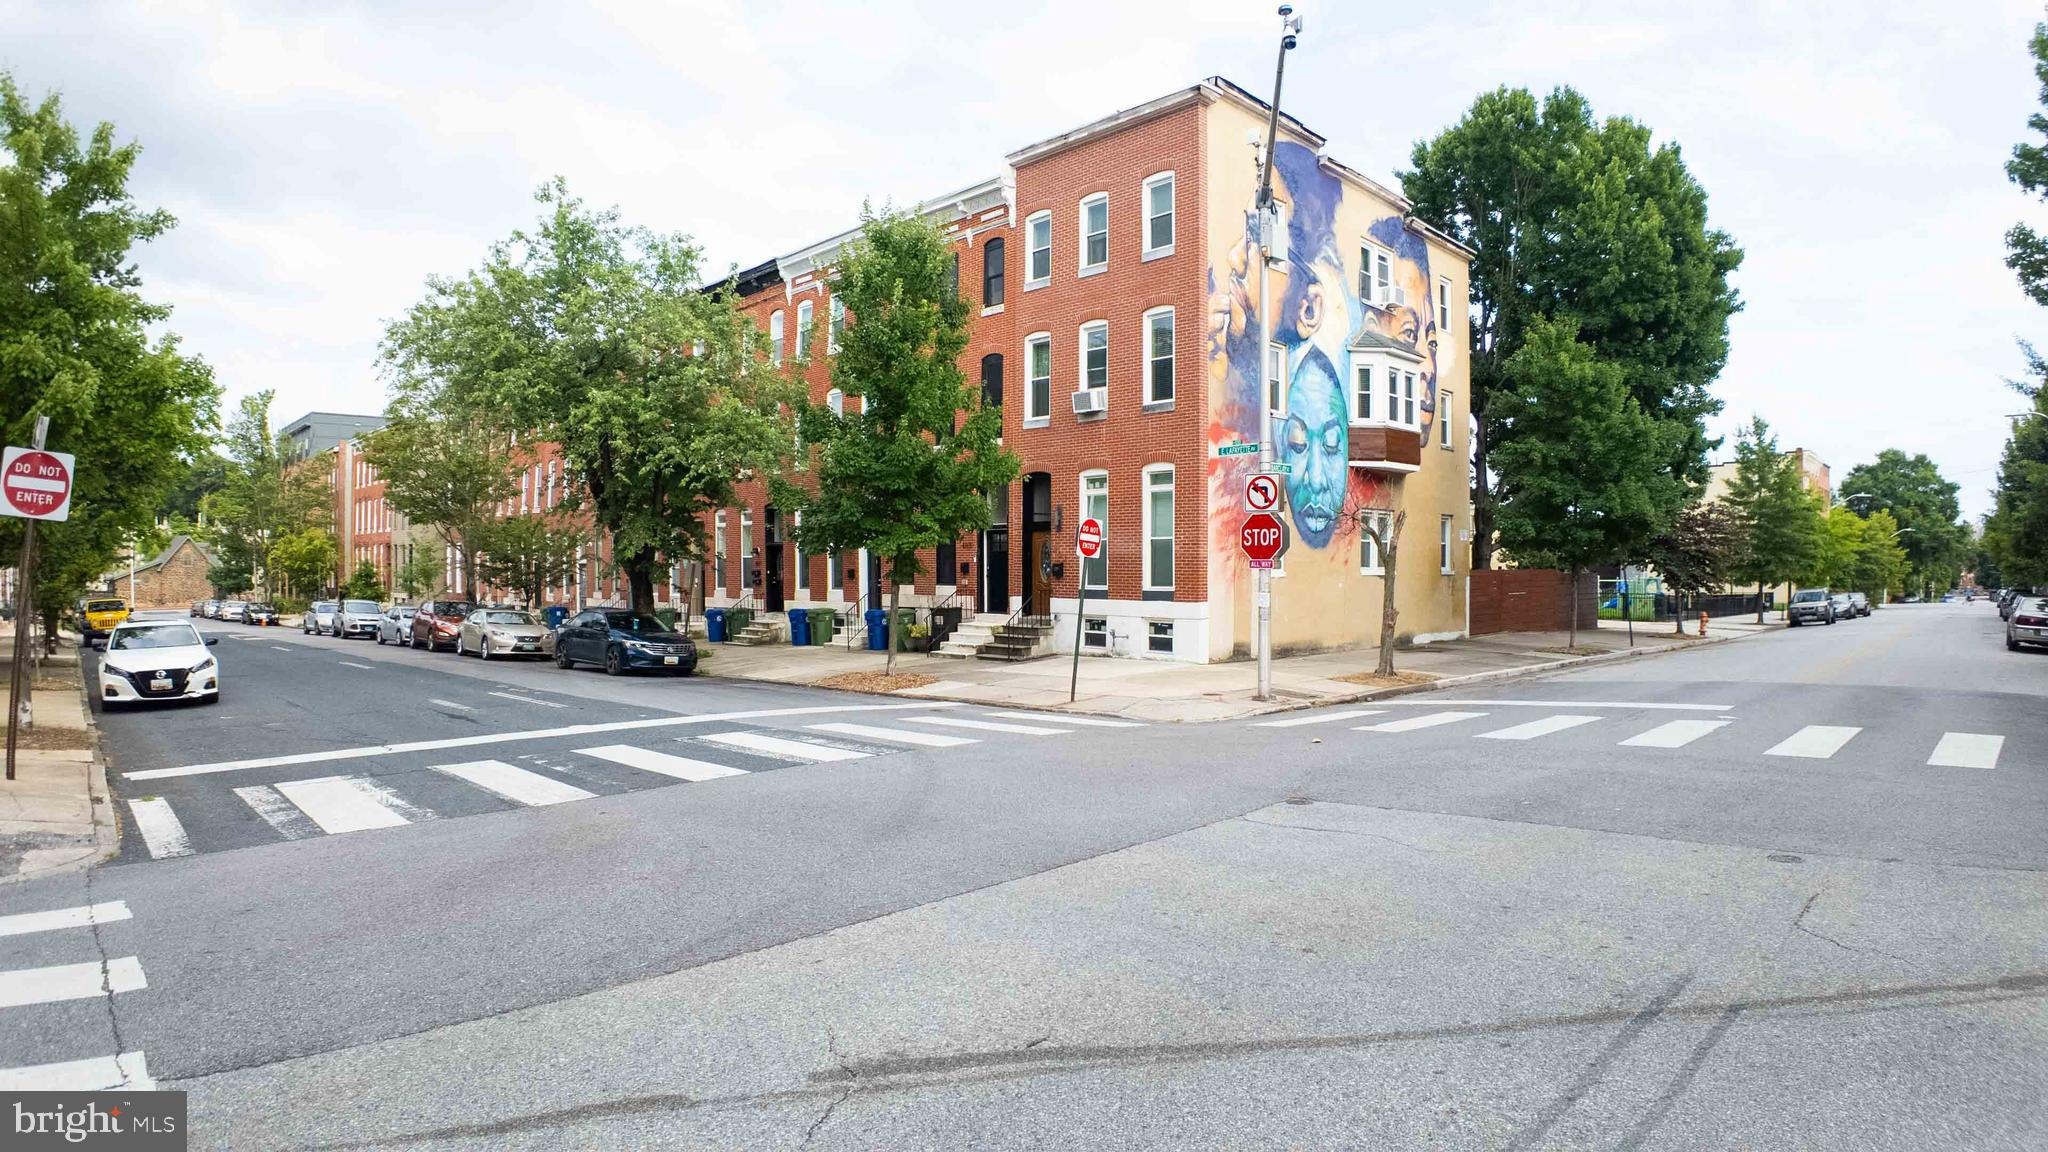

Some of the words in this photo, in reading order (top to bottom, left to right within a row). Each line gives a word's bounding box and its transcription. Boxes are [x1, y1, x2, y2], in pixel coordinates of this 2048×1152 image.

[15, 462, 31, 473] DO
[39, 465, 61, 477] NOT
[16, 491, 53, 505] ENTER
[1243, 528, 1279, 546] STOP
